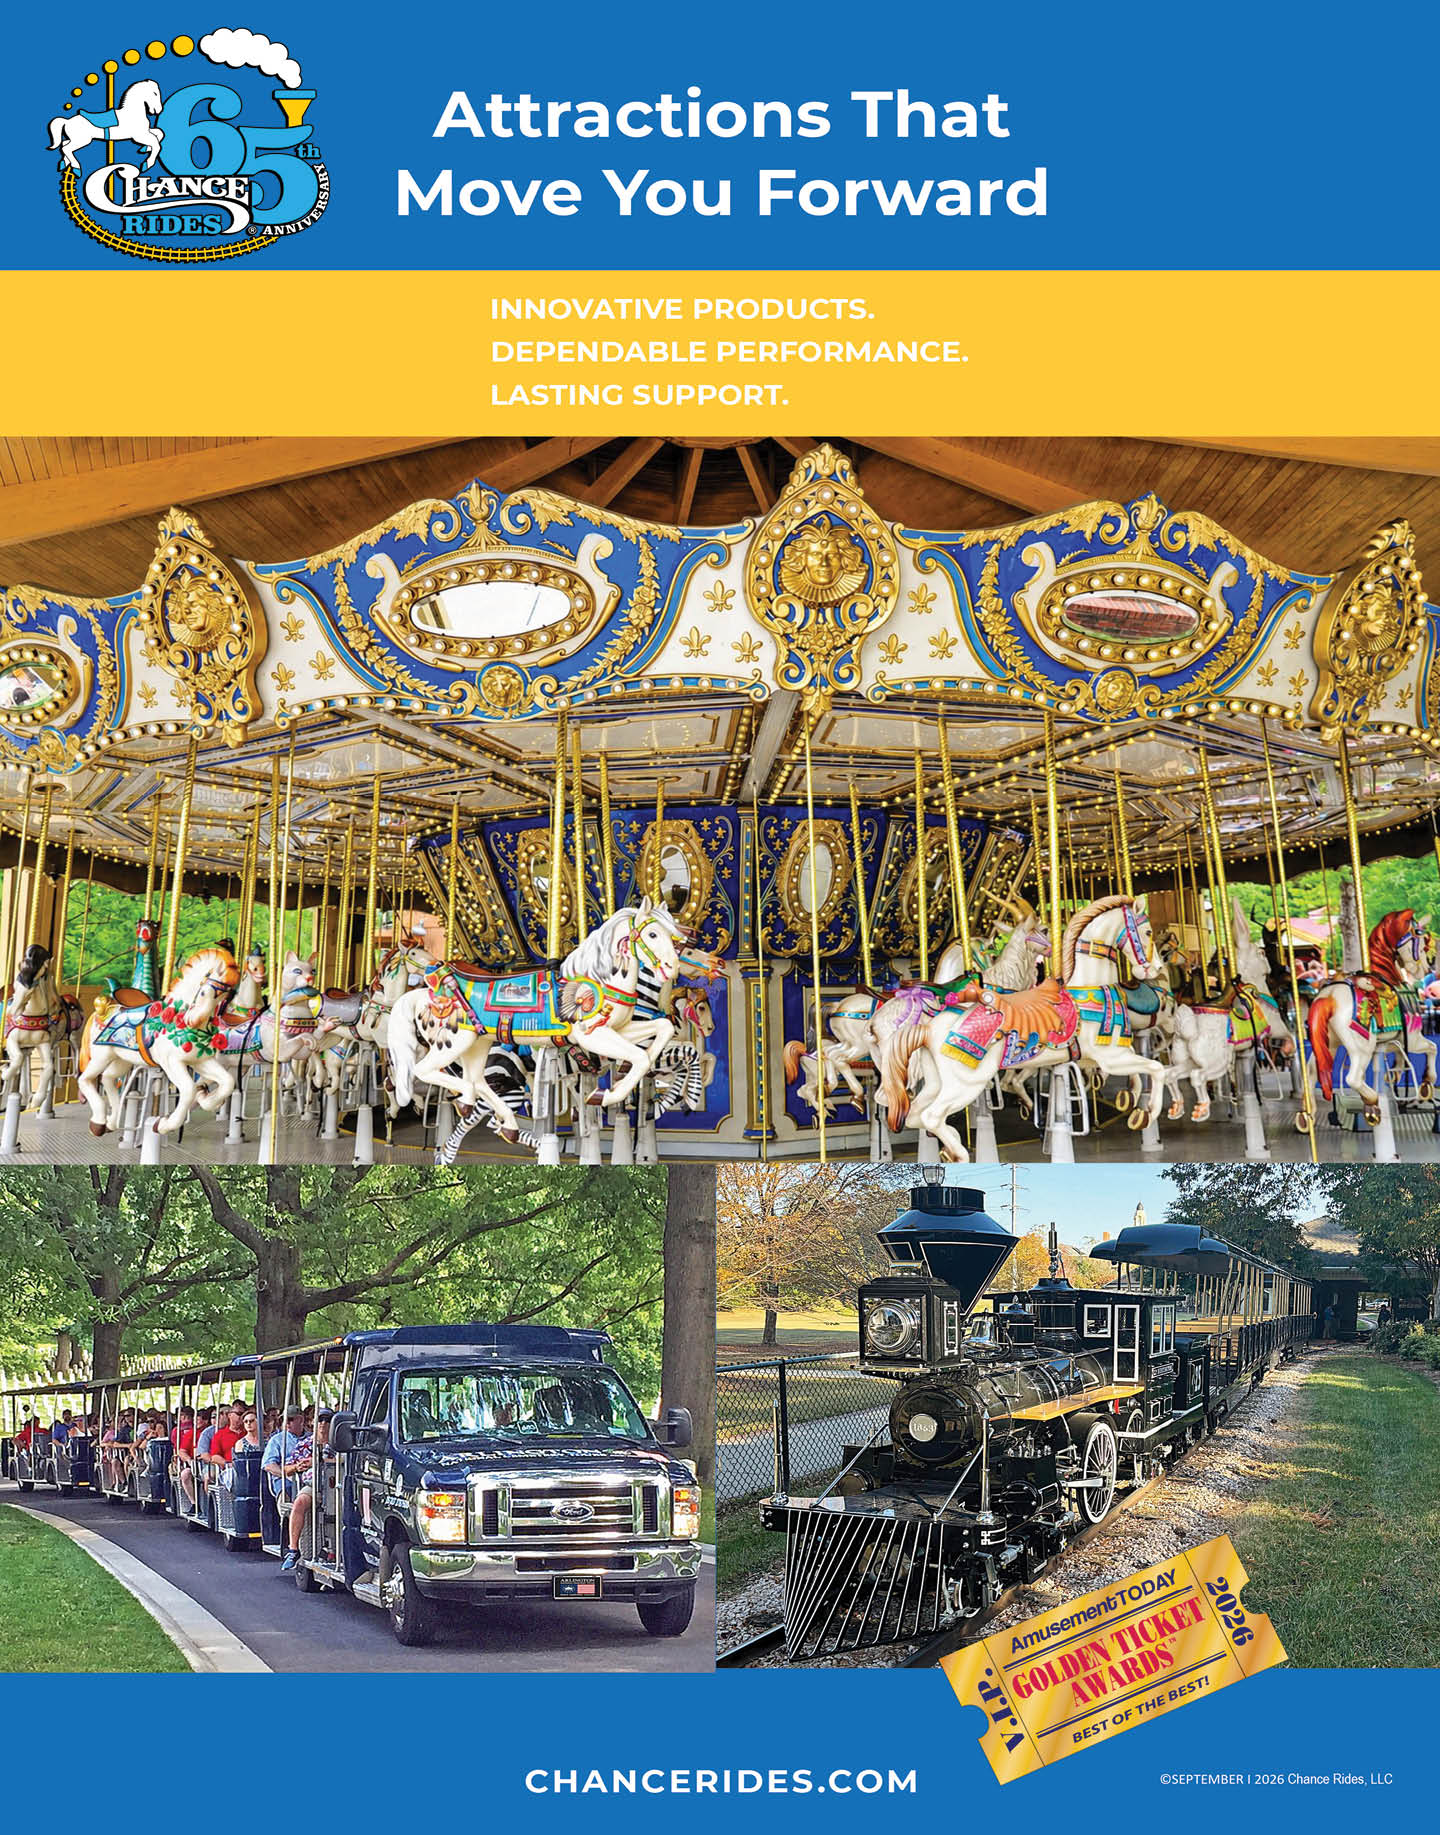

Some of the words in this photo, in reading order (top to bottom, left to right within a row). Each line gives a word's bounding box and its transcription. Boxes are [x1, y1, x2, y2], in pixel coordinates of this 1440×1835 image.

[432, 86, 830, 138] Attractions
[851, 89, 1010, 138] That
[84, 163, 250, 216] CHANCE
[262, 162, 329, 236] ANNIVERSARY
[398, 170, 581, 216] Move
[602, 169, 731, 216] You
[759, 167, 1047, 216] Forward
[122, 214, 222, 235] RIDES
[491, 298, 683, 319] INNOVATIVE
[694, 298, 874, 320] PRODUCTS.
[491, 341, 707, 362] DEPENDABLE
[717, 341, 968, 362] PERFORMANCE.
[491, 384, 622, 405] LASTING
[633, 384, 788, 405] SUPPORT.
[1011, 1569, 1176, 1653] AmusementTODAY
[1205, 1576, 1254, 1646] 2026
[1012, 1638, 1111, 1699] GOLDEN
[1110, 1596, 1206, 1654] TICKET
[978, 1668, 1025, 1753] V.I.P.
[1073, 1719, 1108, 1743] BEST
[1112, 1709, 1133, 1725] OF
[1135, 1694, 1166, 1715] THE
[1169, 1675, 1210, 1702] BEST!
[524, 1769, 917, 1793] CHANCERIDES.COM
[1255, 1773, 1285, 1785] 2026
[1287, 1773, 1330, 1785] Chance
[1333, 1773, 1368, 1787] Rides,
[1370, 1773, 1393, 1785] LLC
